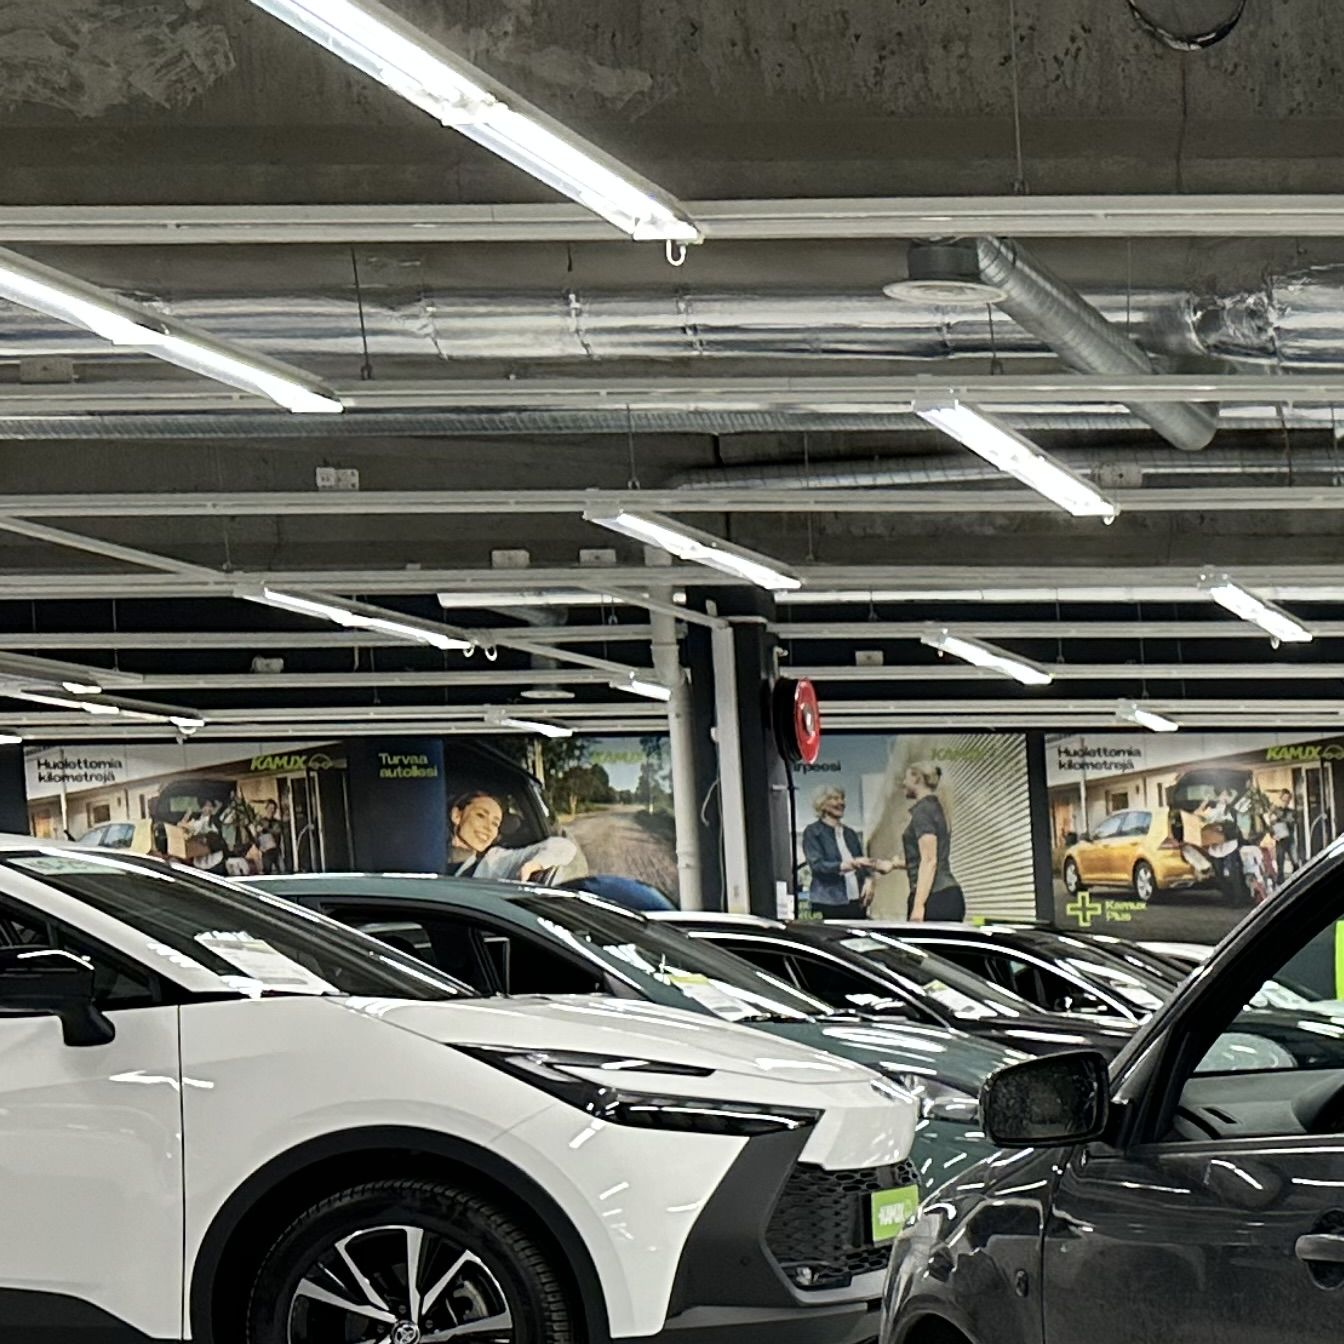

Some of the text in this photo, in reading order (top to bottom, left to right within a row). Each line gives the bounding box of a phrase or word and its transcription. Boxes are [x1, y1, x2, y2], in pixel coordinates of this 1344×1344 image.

[1057, 746, 1142, 759] Huolettomia
[1265, 746, 1323, 761] KAMUX
[37, 758, 123, 770] Huolettomia
[250, 754, 309, 771] KAMUX
[378, 753, 429, 765] Turvaa
[1058, 759, 1134, 772] kilometrejä
[38, 770, 116, 783] kilometrejä
[379, 766, 438, 778] autollesi
[1105, 900, 1147, 910] Kamux
[1105, 911, 1132, 922] Plus
